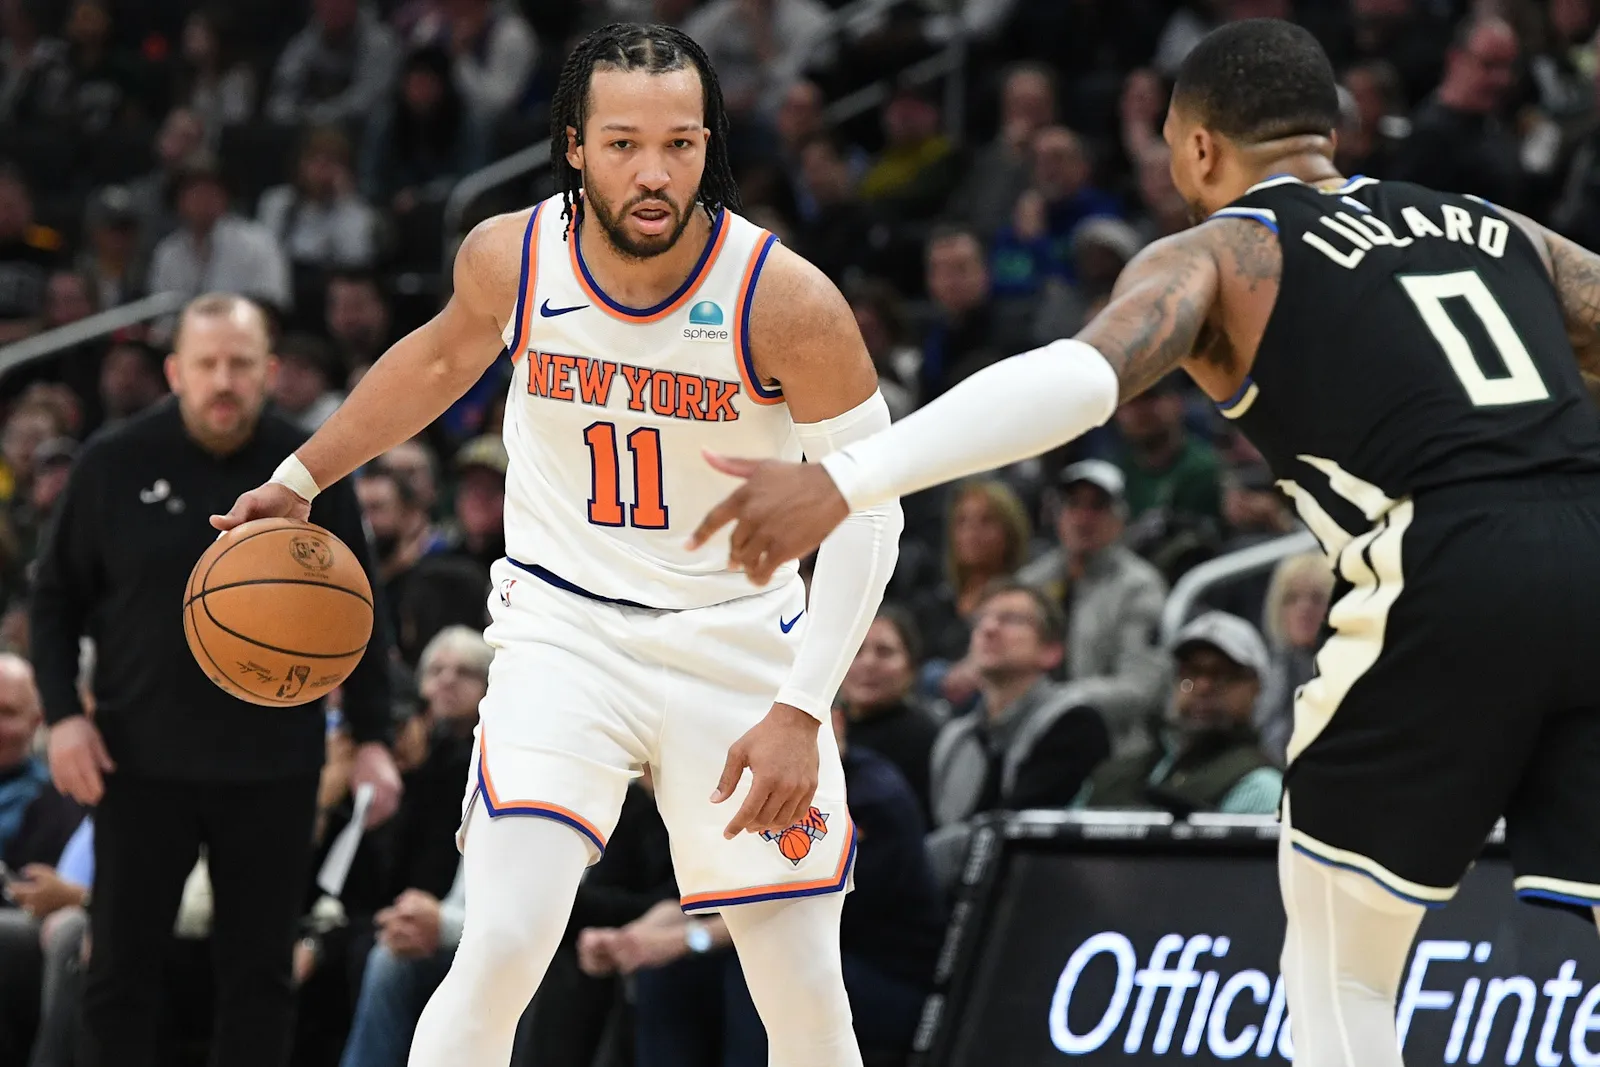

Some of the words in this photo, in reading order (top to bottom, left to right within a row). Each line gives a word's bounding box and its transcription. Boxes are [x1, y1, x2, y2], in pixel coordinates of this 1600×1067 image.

[1302, 203, 1510, 269] LILLARD
[683, 327, 729, 341] sphere
[1398, 266, 1551, 407] 0
[527, 349, 617, 408] NEW
[621, 363, 741, 422] YORK
[583, 421, 669, 530] 11
